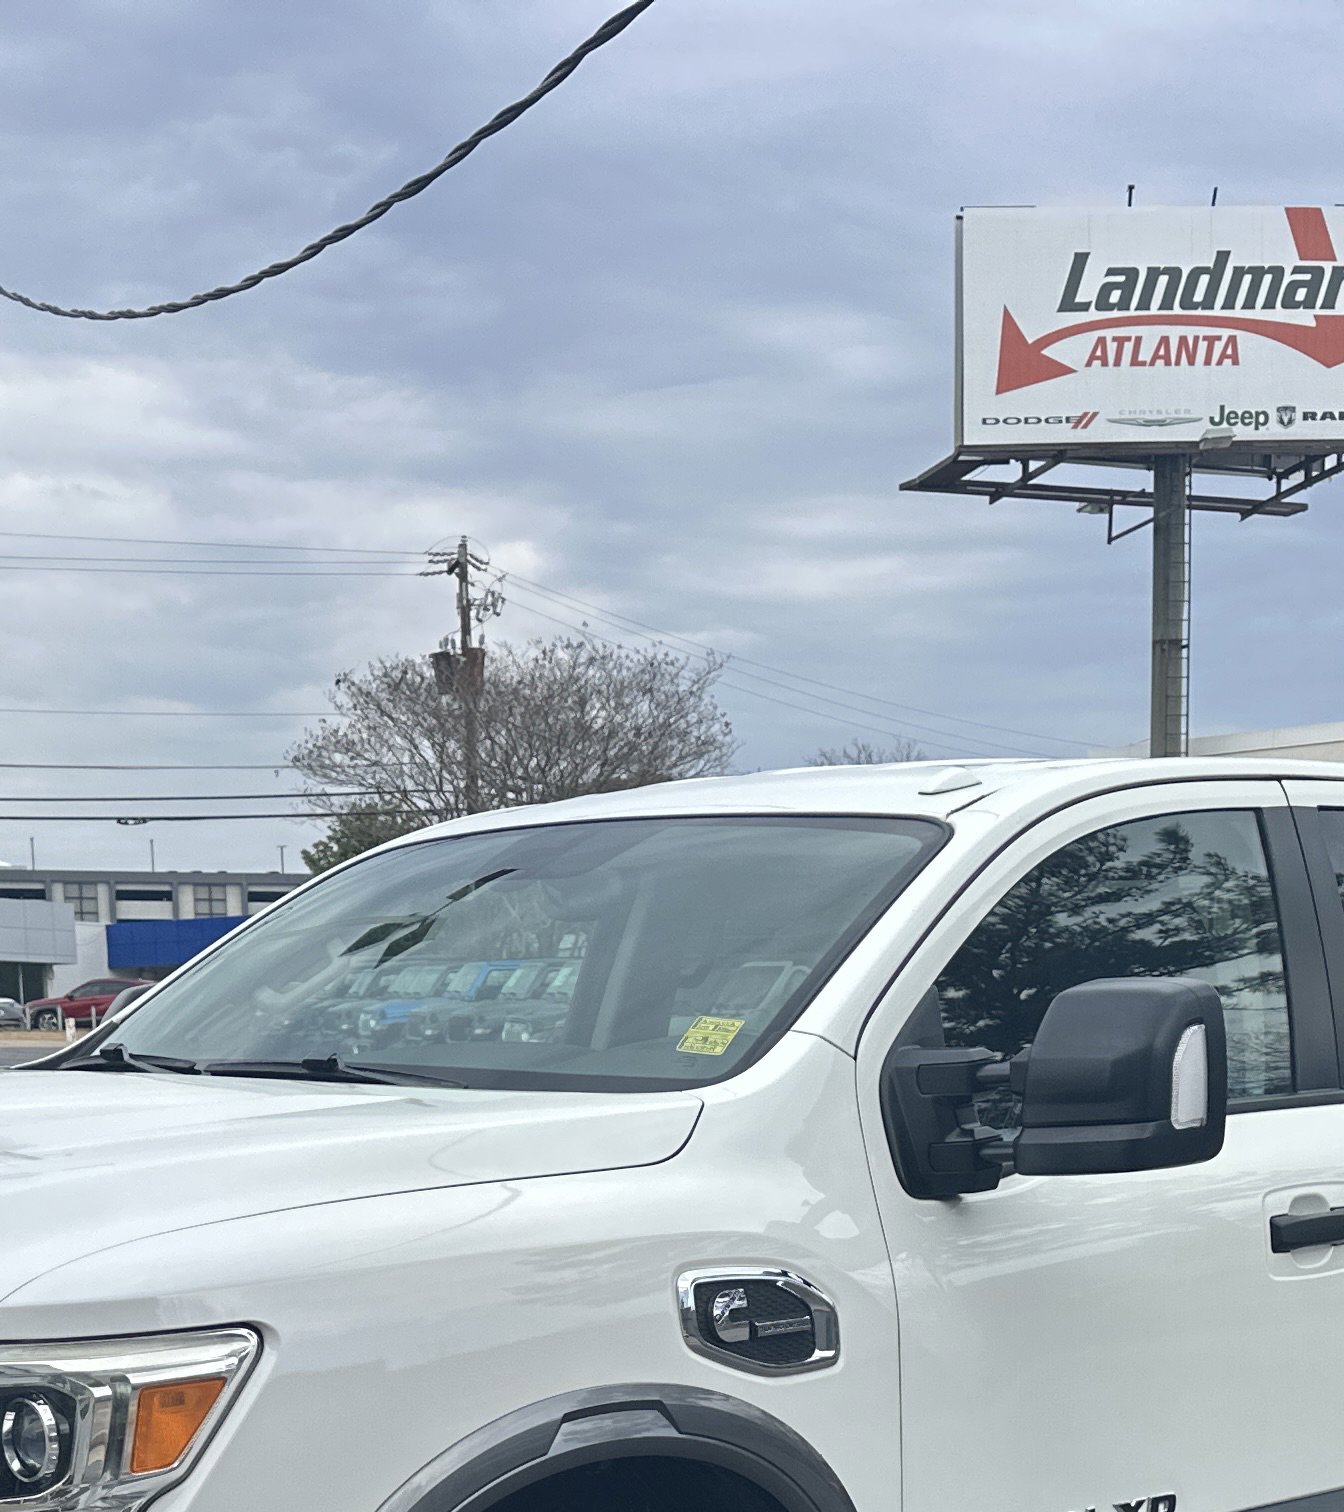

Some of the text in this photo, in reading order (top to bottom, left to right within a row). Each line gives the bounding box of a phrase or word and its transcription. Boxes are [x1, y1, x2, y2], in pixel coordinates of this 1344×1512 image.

[1084, 334, 1241, 368] ATLANTA
[981, 415, 1081, 426] DODGE
[1118, 408, 1193, 416] CHRYSLER
[1208, 404, 1270, 431] Jeep
